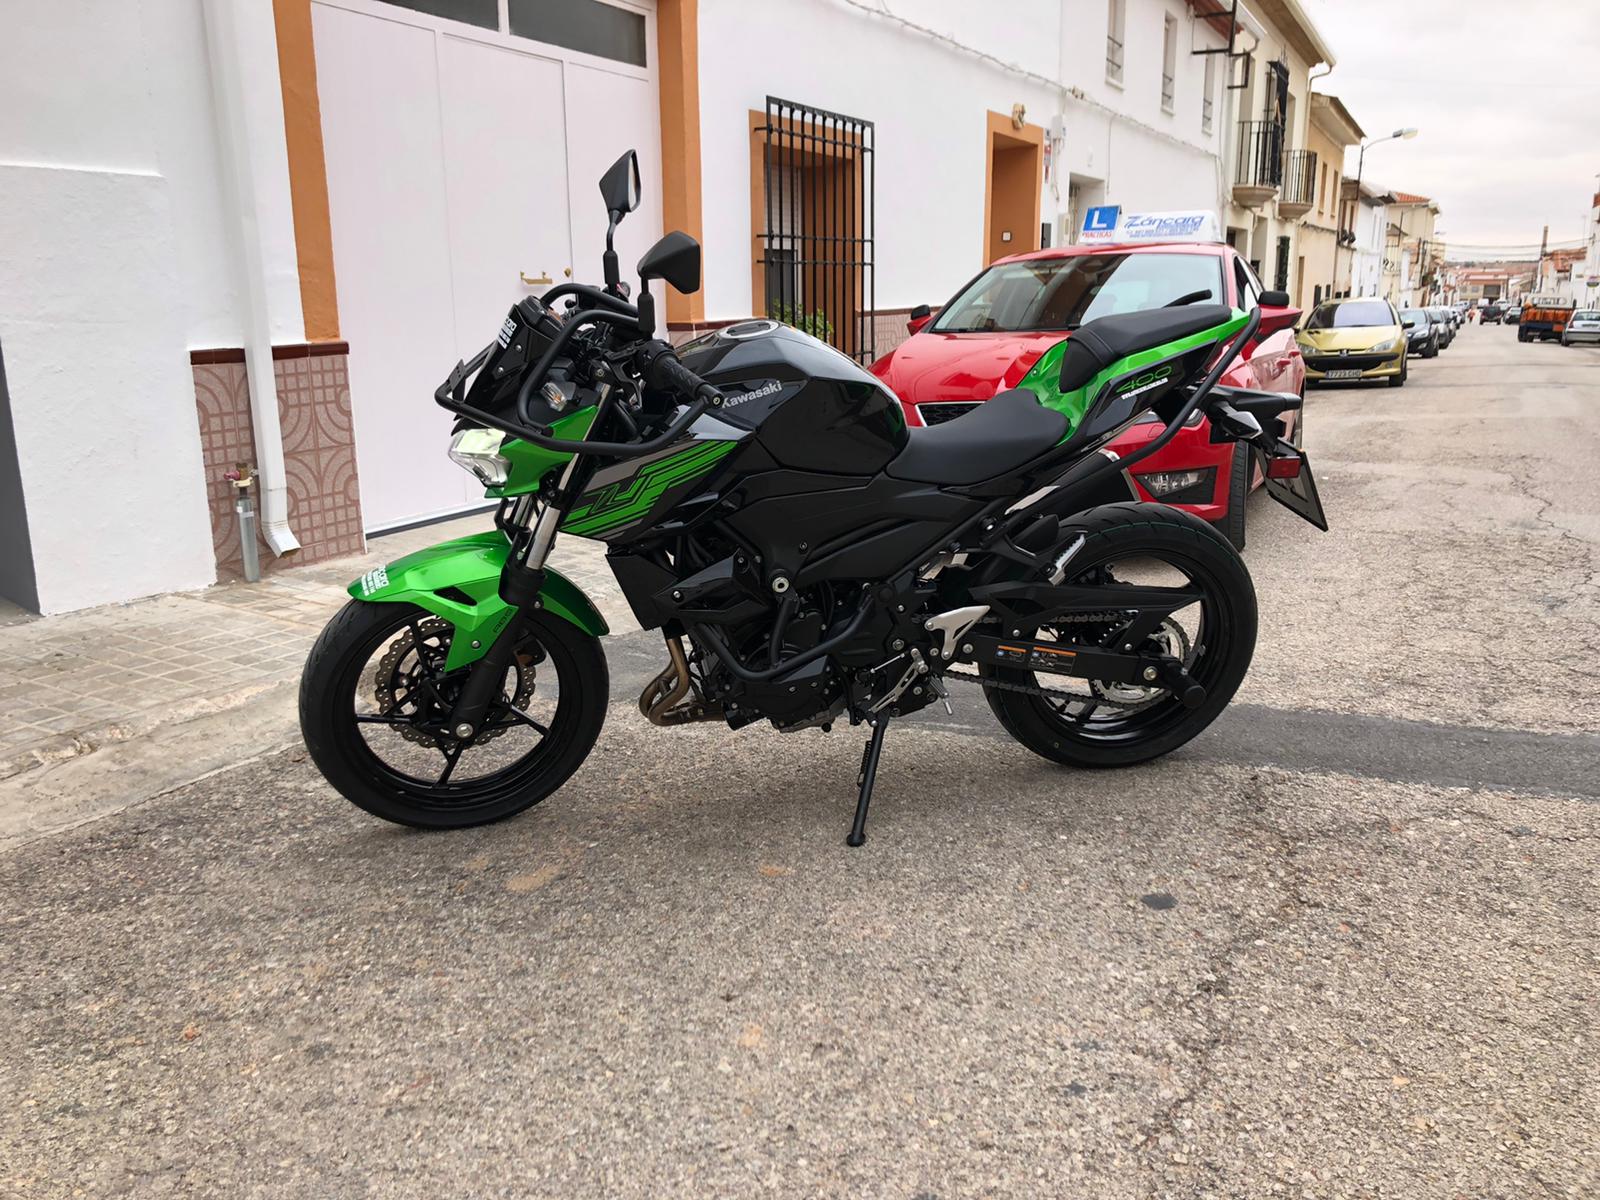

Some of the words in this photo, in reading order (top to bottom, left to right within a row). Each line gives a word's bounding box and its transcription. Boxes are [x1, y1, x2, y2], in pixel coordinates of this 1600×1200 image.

[1091, 210, 1107, 228] L
[1116, 366, 1171, 392] 400
[721, 380, 782, 408] Kawasaki
